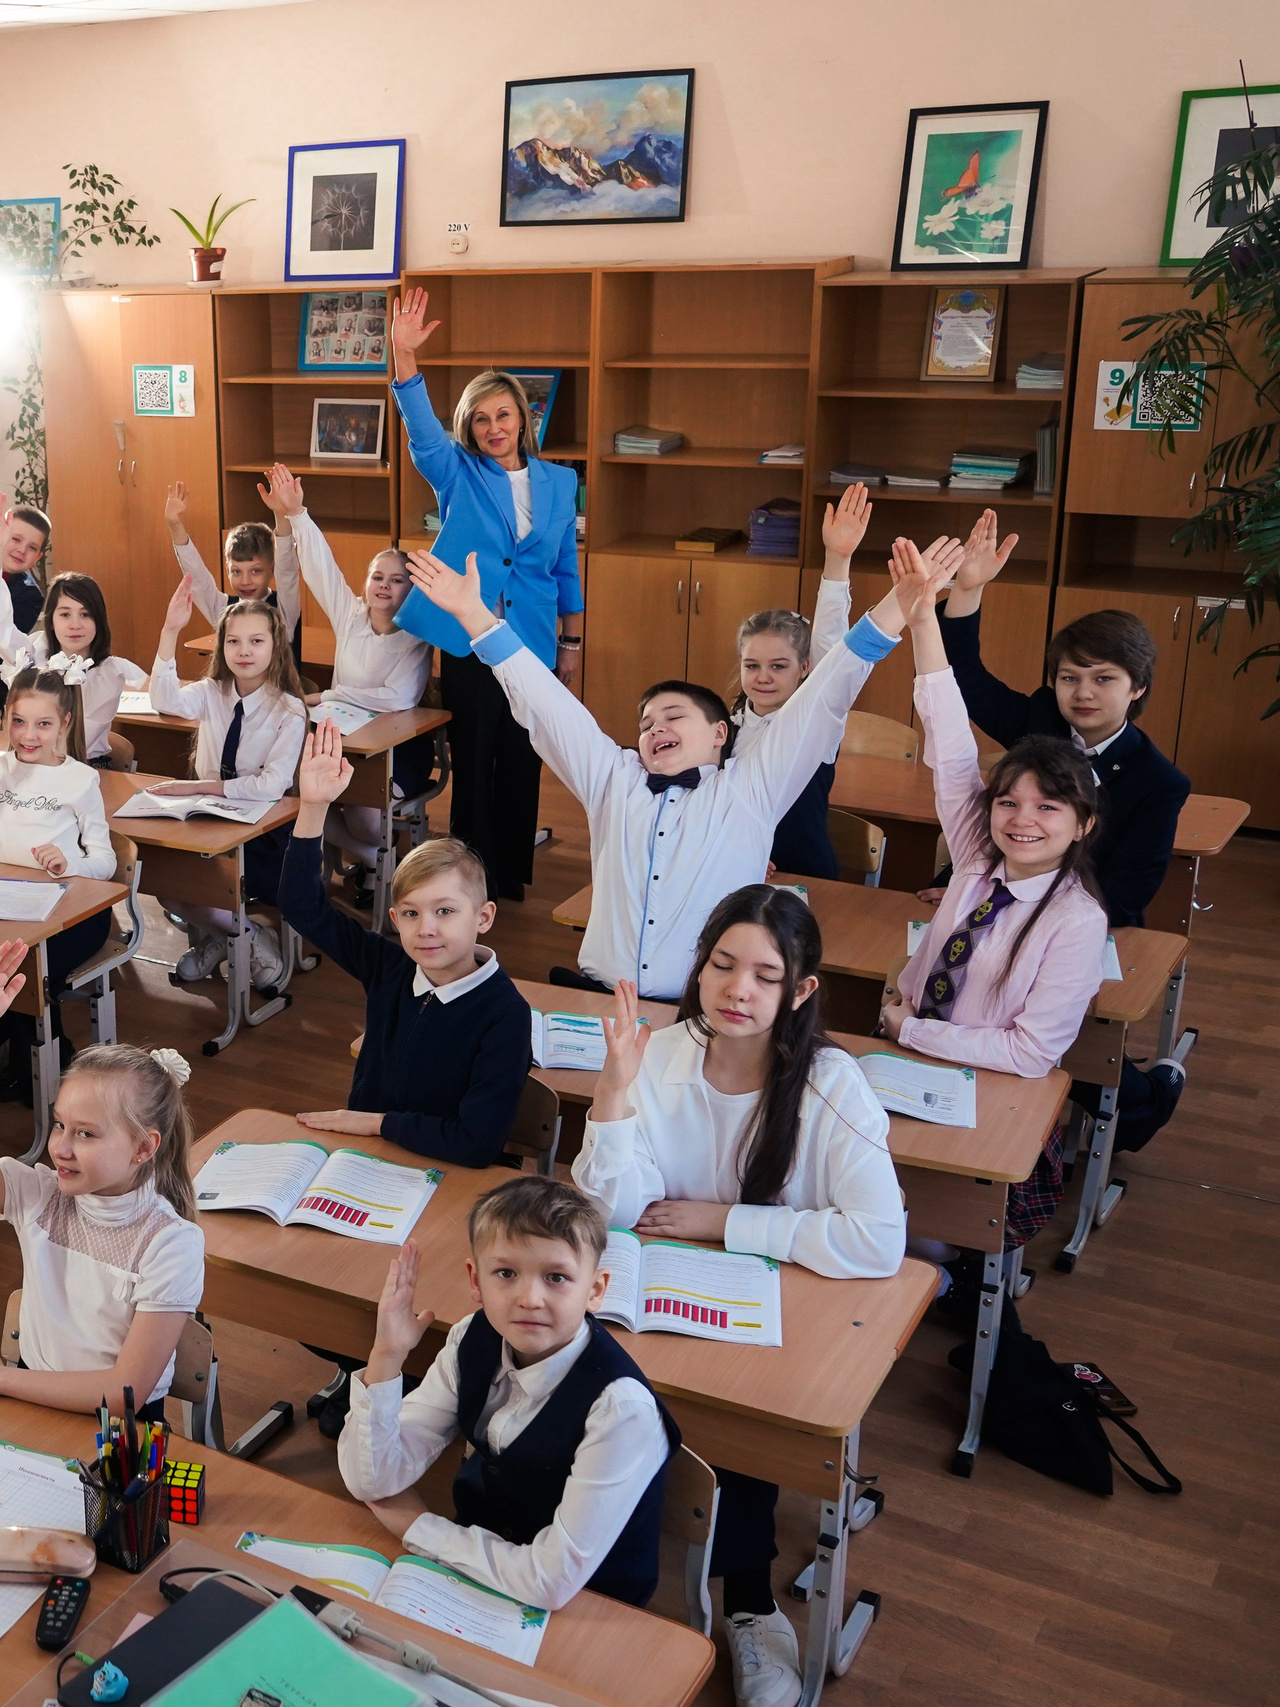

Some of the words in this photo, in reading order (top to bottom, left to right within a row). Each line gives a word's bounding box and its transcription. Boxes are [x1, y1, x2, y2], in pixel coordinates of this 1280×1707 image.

[448, 223, 461, 231] 220
[464, 223, 470, 231] V
[178, 370, 188, 384] 8
[1109, 368, 1125, 386] 9
